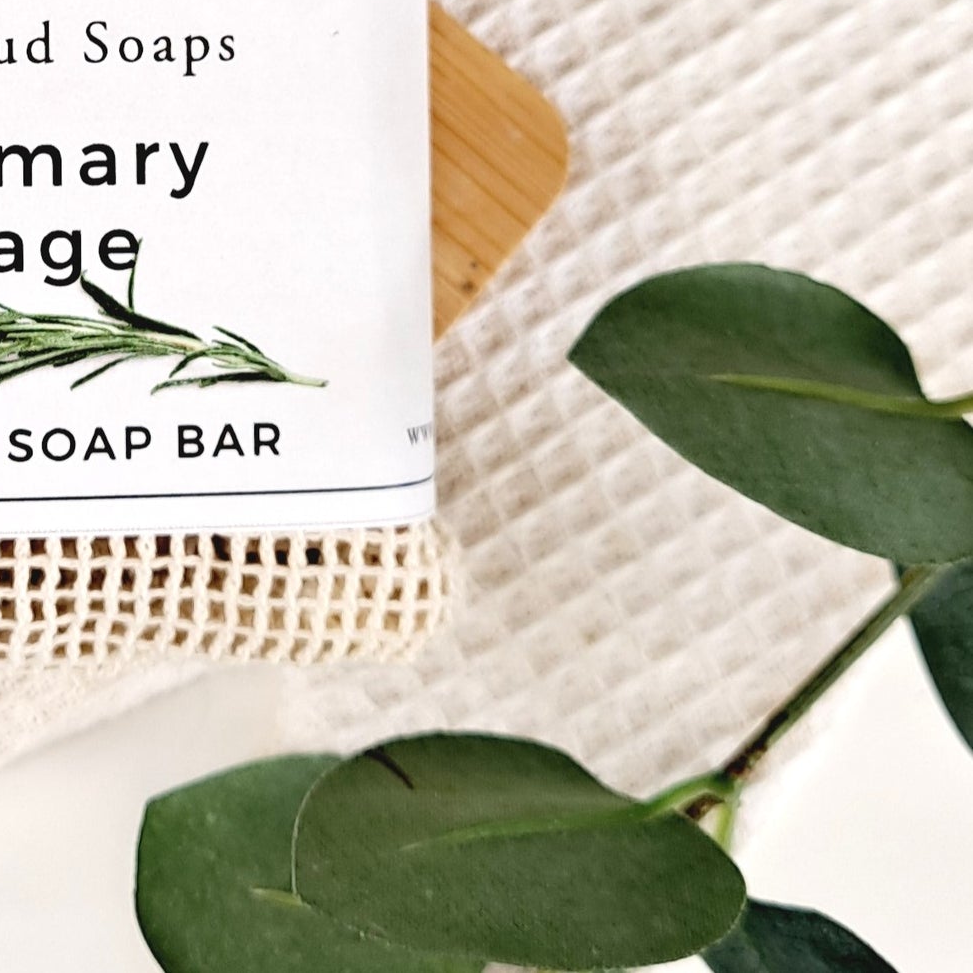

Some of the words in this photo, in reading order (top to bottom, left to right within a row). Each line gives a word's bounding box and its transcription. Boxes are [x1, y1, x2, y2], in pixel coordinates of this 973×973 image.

[83, 20, 235, 77] Soaps
[7, 425, 152, 463] SOAP
[177, 422, 281, 459] BAR
